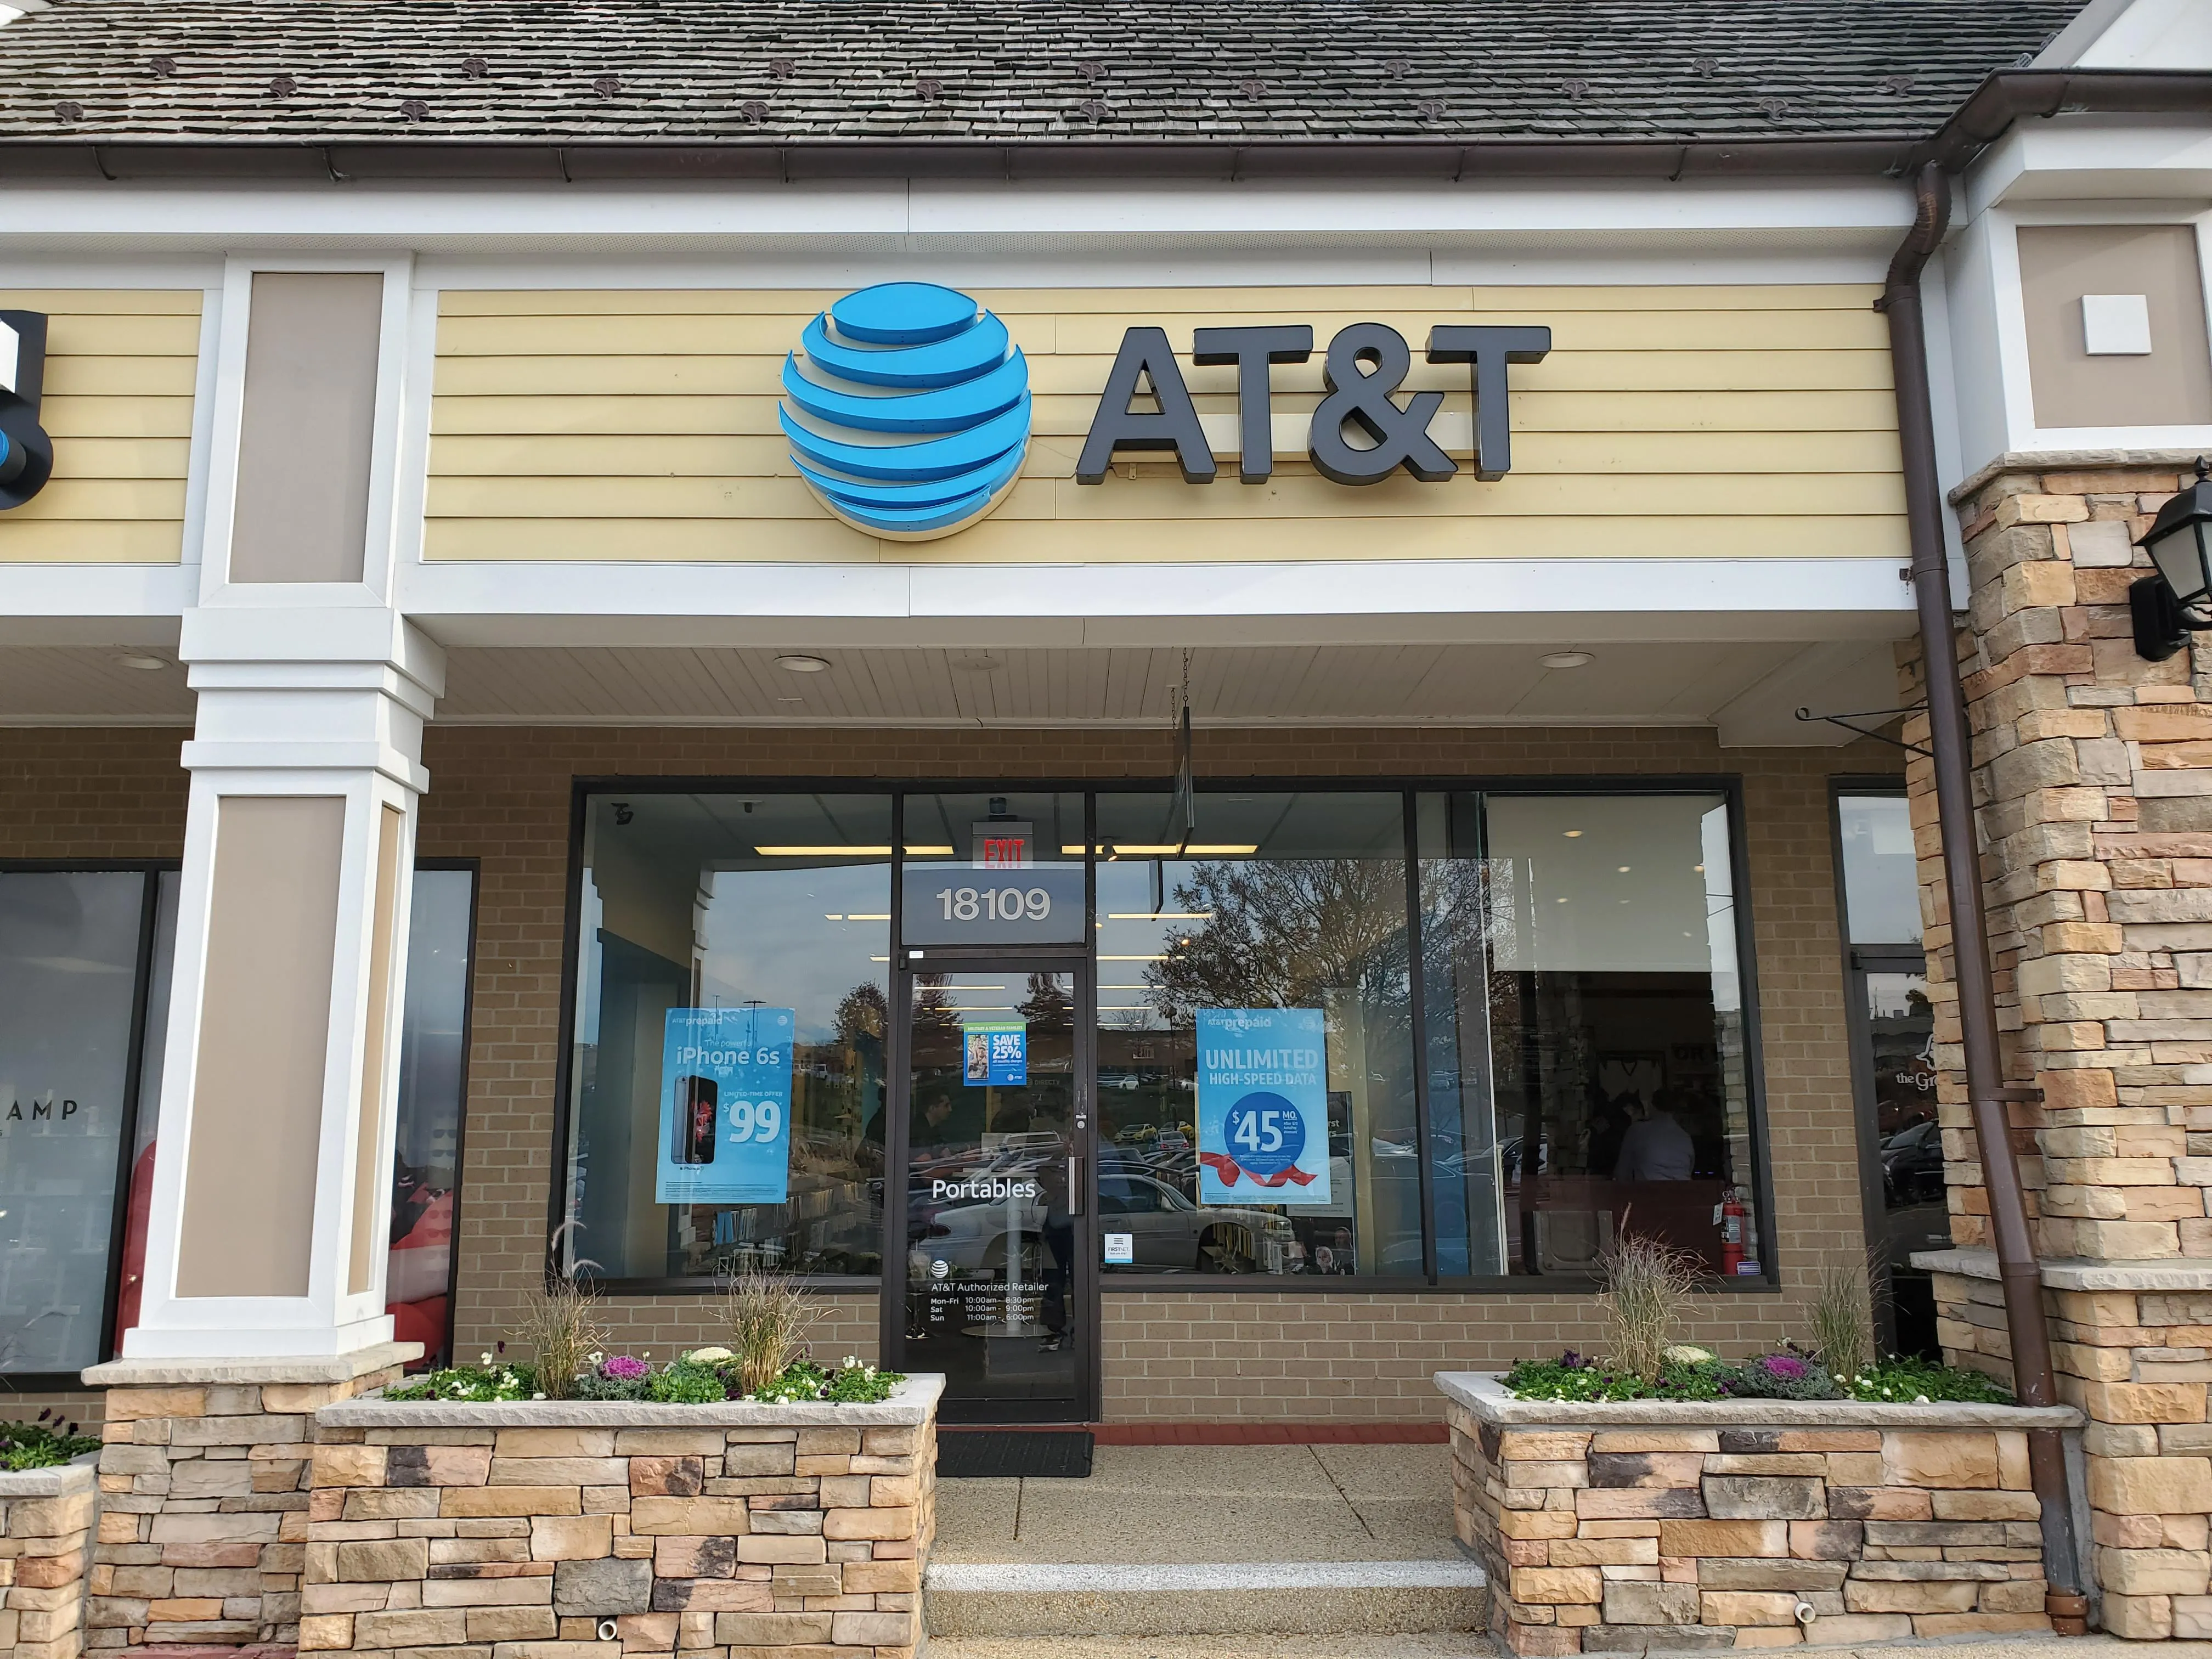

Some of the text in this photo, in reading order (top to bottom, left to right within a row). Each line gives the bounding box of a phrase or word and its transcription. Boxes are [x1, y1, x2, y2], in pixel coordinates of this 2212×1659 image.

[1076, 322, 1551, 486] AT&T
[984, 839, 1024, 868] EXIT
[936, 888, 1051, 921] 18109
[686, 1013, 723, 1026] prepaid
[1224, 1016, 1272, 1030] prepaid
[992, 1034, 1021, 1046] SAVE
[676, 1046, 780, 1065] iPhone 6s
[992, 1046, 1022, 1059] 25%
[1205, 1049, 1318, 1069] UNLIMITED
[1210, 1073, 1317, 1085] HIGH-SPEED DATA
[1915, 1072, 1937, 1091] Gr
[723, 1100, 781, 1143] $99
[1232, 1110, 1297, 1152] $45 MO.
[1328, 1119, 1340, 1127] rst
[932, 1178, 1036, 1198] Portables
[931, 1283, 1048, 1291] AT&T Authorized Retailer
